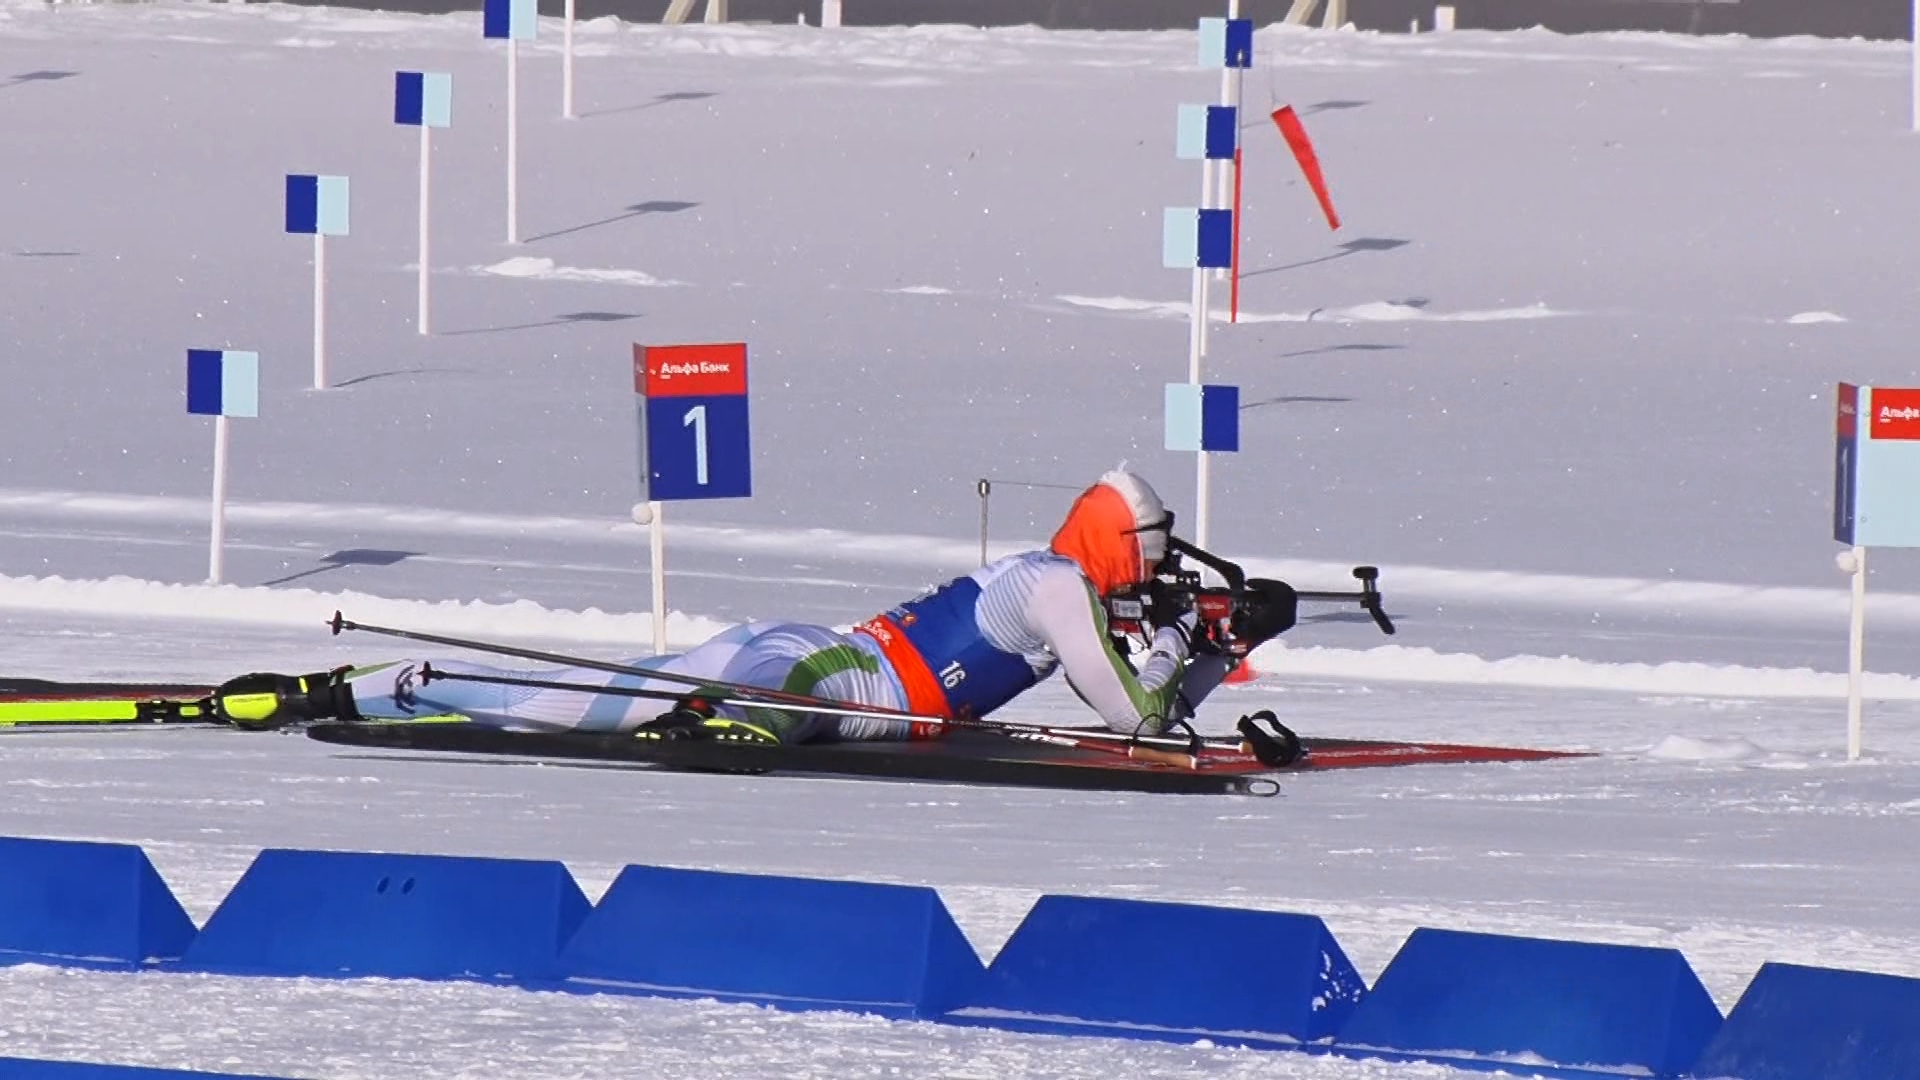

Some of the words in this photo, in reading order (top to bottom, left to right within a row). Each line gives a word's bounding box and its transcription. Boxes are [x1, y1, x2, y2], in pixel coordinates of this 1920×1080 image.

[660, 361, 699, 376] Альфа
[700, 361, 730, 374] Банк
[683, 405, 708, 485] 1
[939, 660, 966, 689] 16
